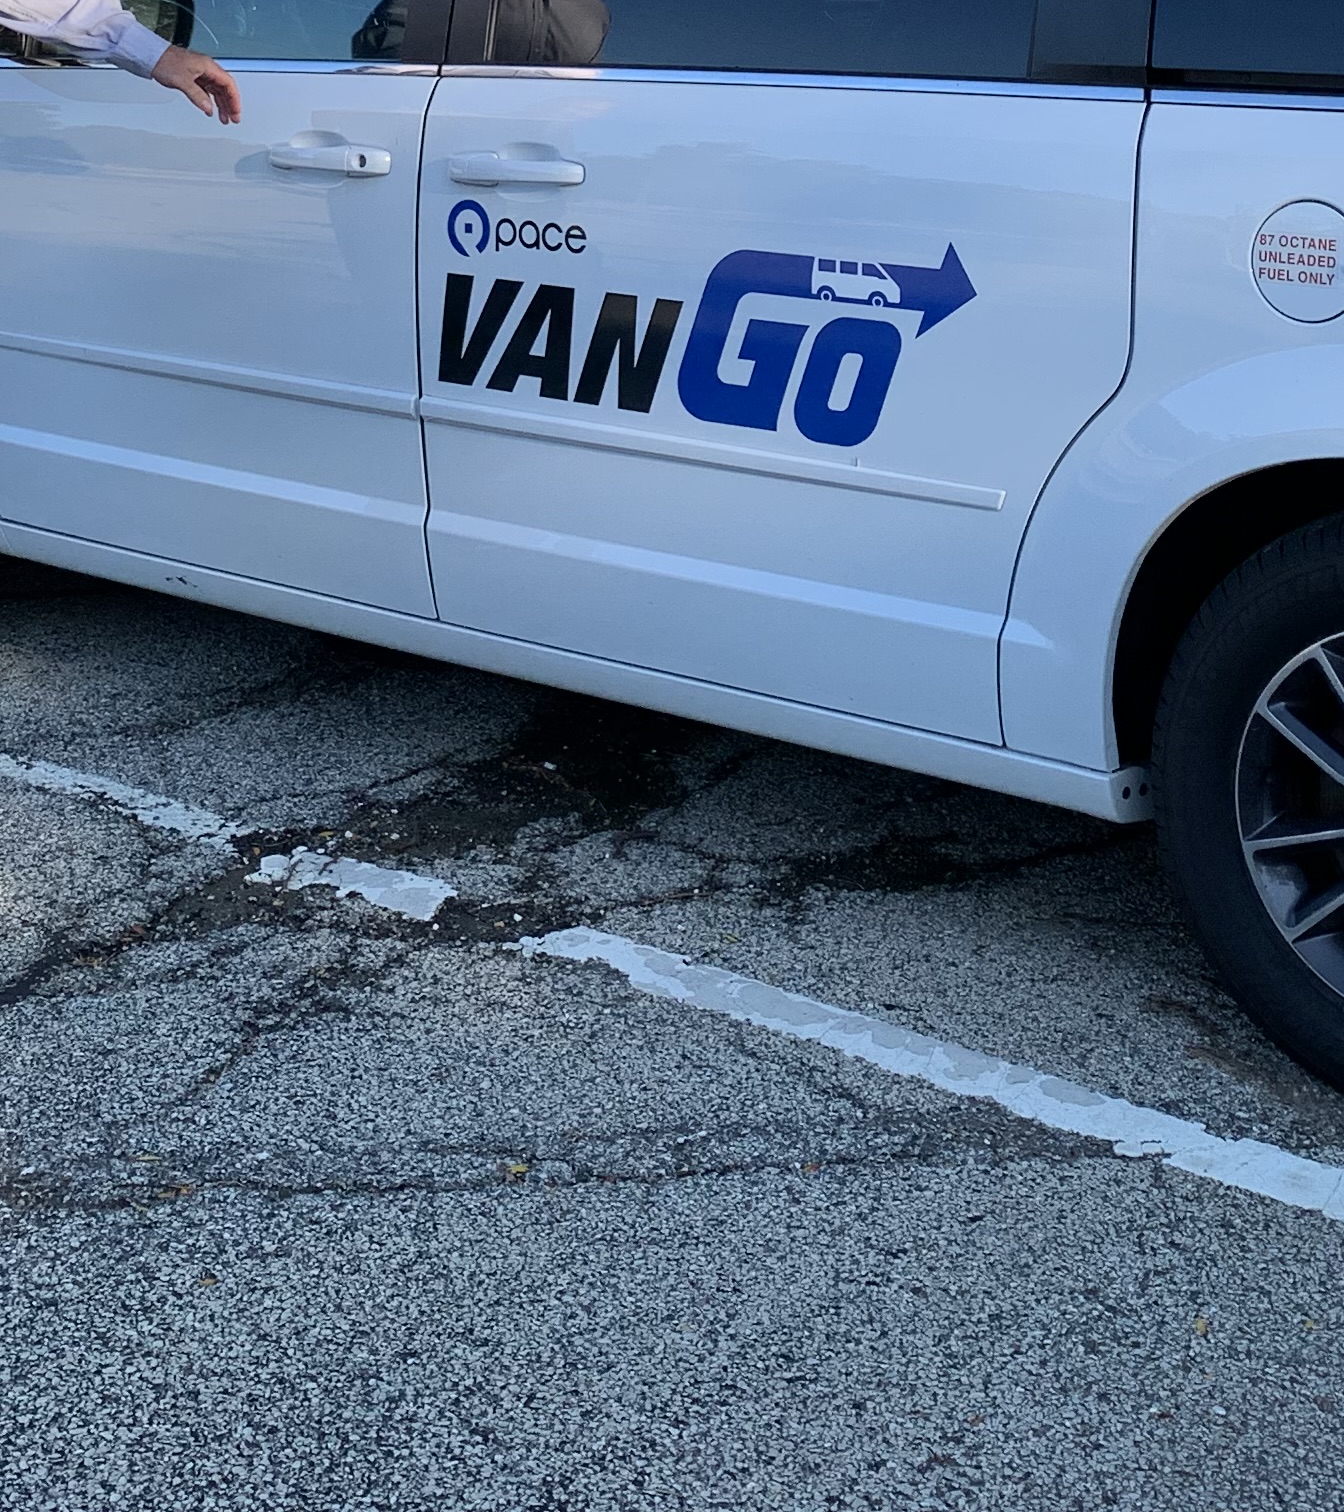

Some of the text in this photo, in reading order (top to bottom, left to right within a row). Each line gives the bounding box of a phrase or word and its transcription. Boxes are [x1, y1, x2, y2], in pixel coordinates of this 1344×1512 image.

[495, 217, 587, 254] pace
[1259, 233, 1337, 252] 87 OCTANE
[1258, 250, 1336, 268] UNLEADED
[1258, 266, 1335, 286] FUEL ONLY
